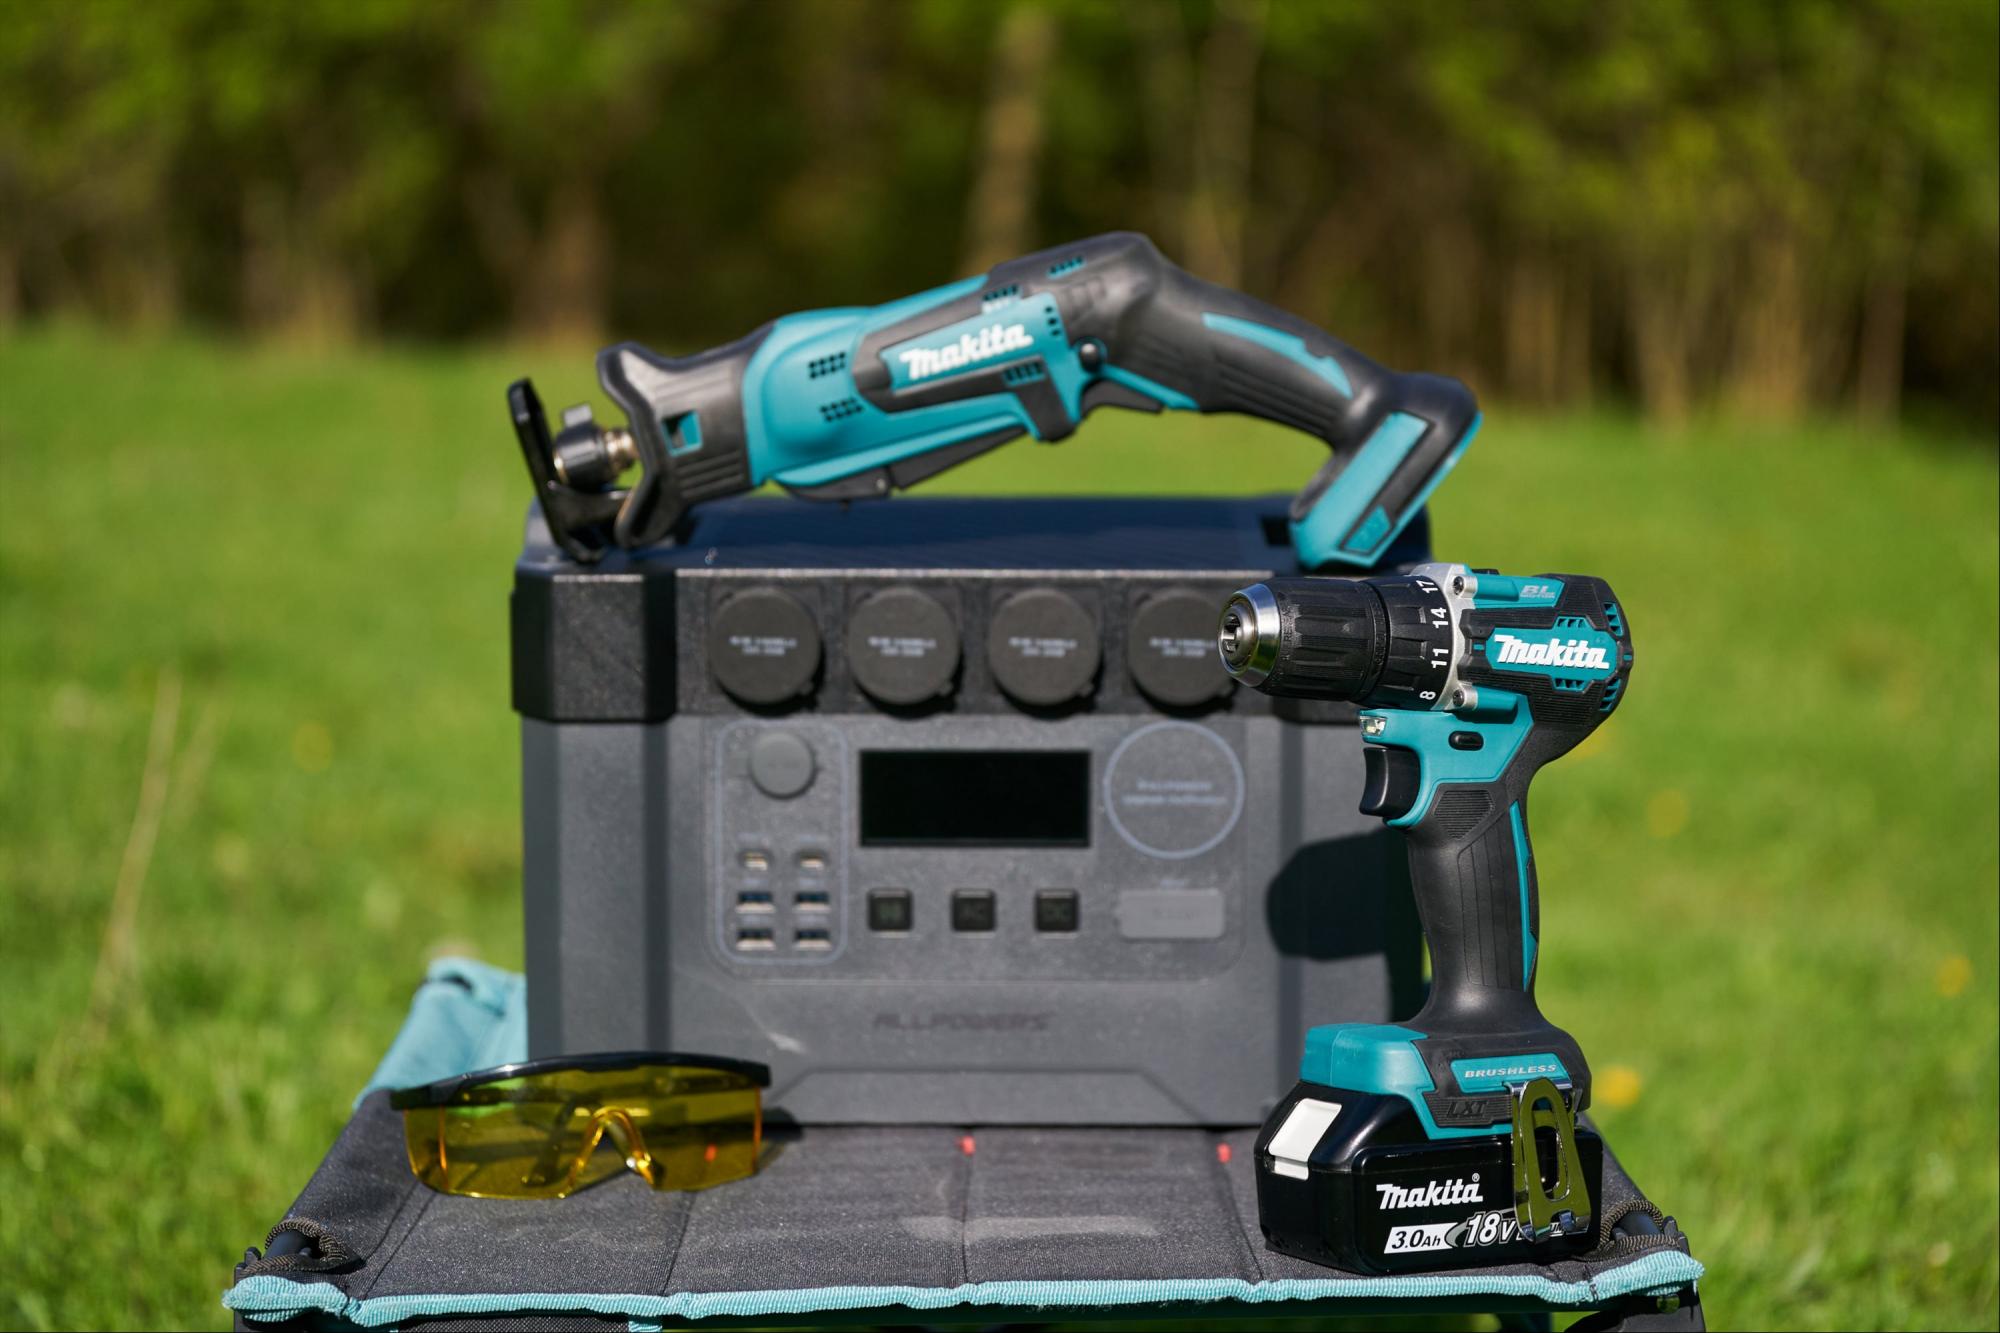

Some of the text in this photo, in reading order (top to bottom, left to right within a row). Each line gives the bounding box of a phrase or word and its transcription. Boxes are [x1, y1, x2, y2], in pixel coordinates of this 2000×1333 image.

[899, 324, 1034, 380] Makita
[1416, 580, 1438, 594] 17
[1430, 607, 1449, 628] 14
[1431, 648, 1449, 668] 11
[1494, 634, 1610, 669] Makita
[1419, 690, 1436, 700] 8
[1464, 1064, 1557, 1078] BRUSHLESS
[1446, 1100, 1490, 1118] LXT
[1391, 1229, 1441, 1249] 3.0Ah
